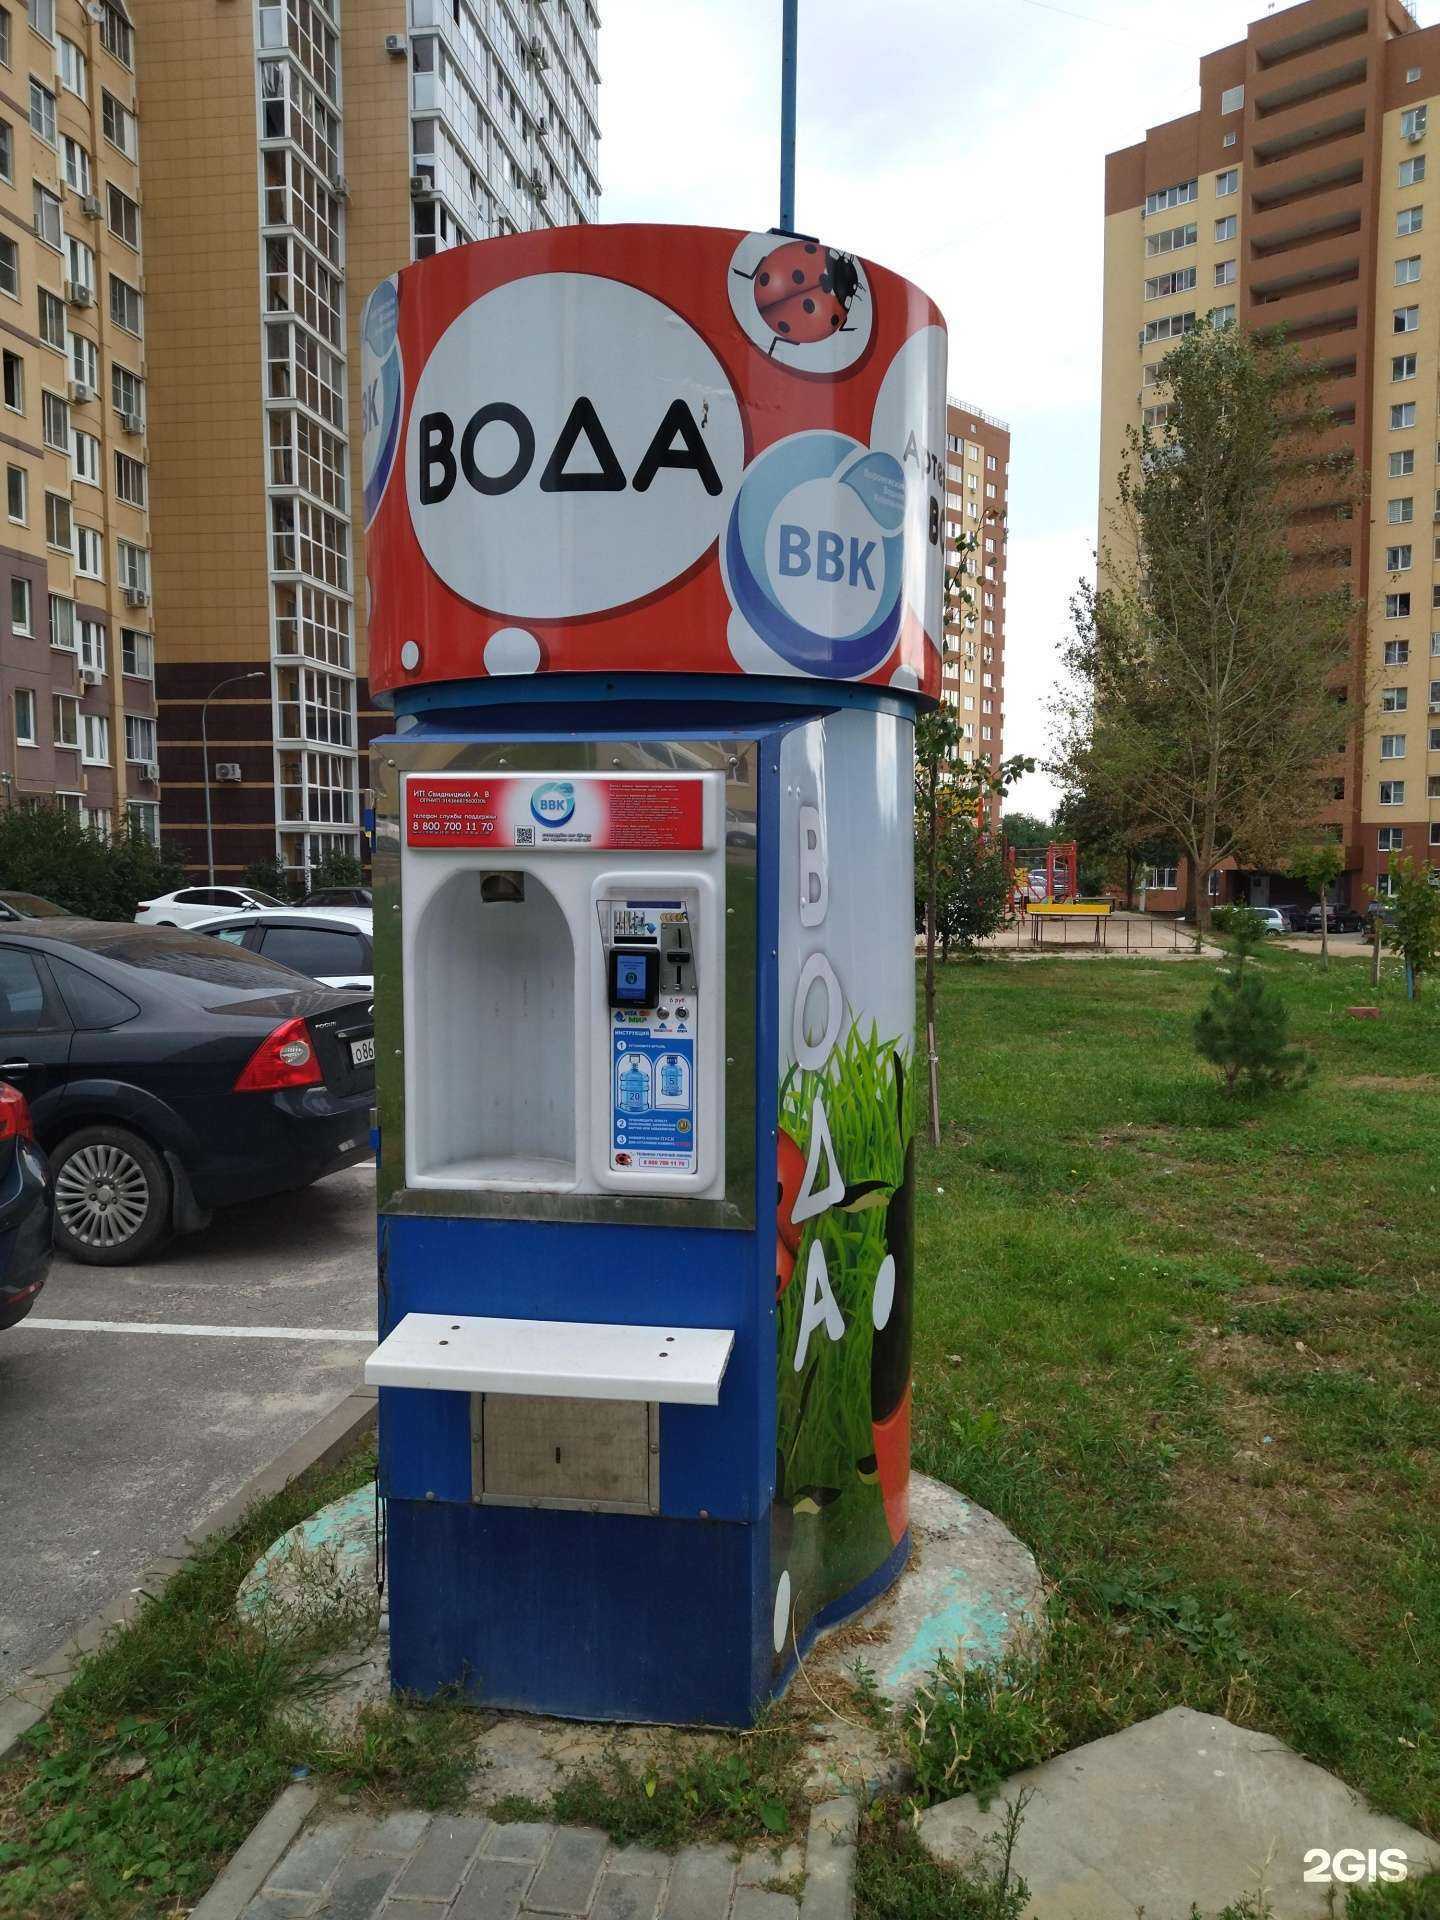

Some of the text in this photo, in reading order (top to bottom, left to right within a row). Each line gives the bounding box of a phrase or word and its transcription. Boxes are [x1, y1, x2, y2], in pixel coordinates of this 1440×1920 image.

[419, 396, 723, 505] ВОДА
[778, 523, 877, 592] ВВК
[413, 789, 425, 797] ИП
[540, 799, 566, 811] ВВК
[413, 821, 494, 831] 8 800 700 11 70
[791, 804, 845, 1373] ВОДА
